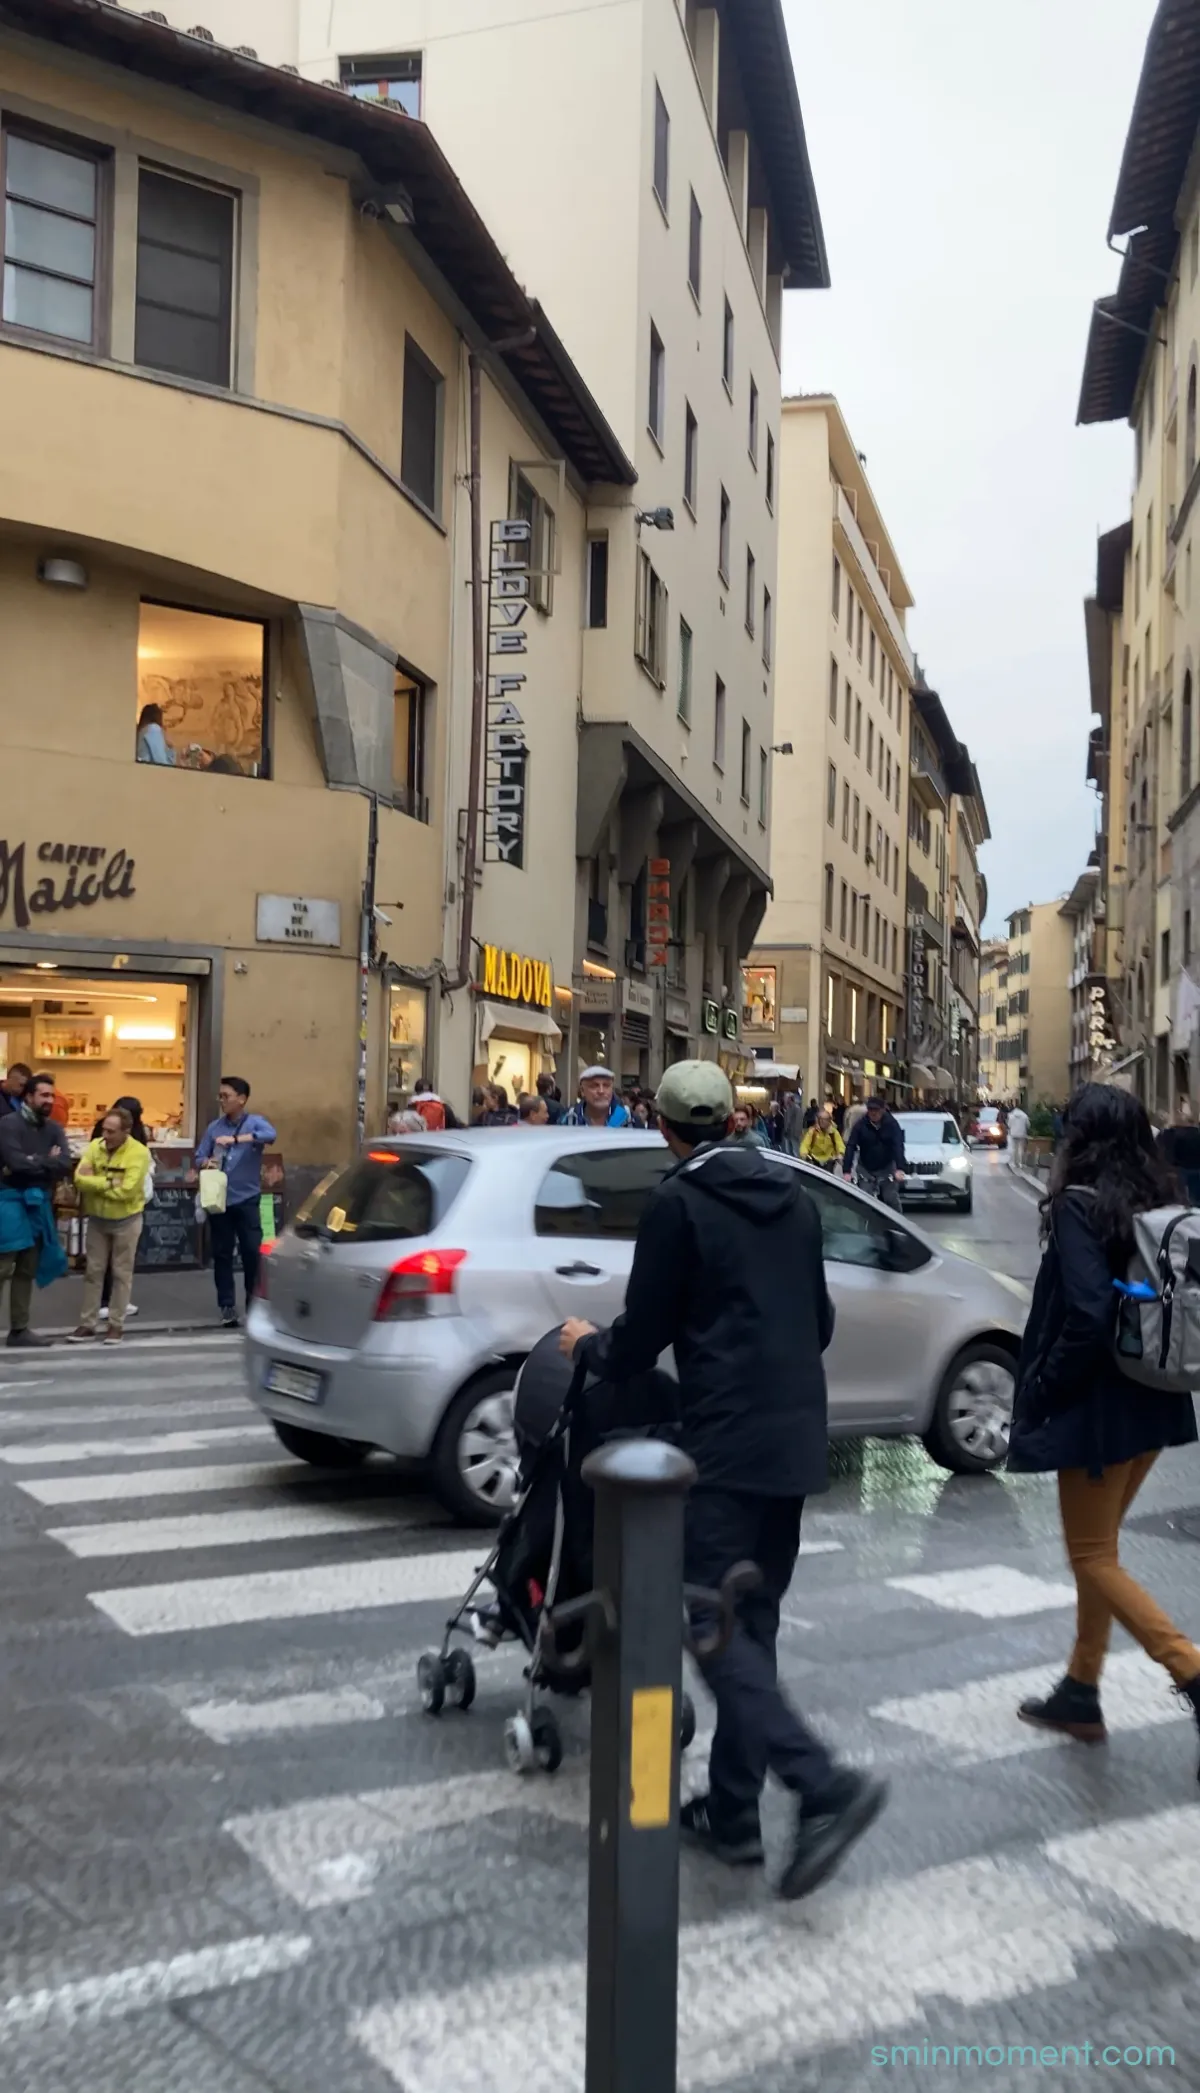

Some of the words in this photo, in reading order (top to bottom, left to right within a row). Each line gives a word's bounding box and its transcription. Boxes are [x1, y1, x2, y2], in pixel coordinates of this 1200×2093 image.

[496, 520, 530, 653] GLOVE
[492, 673, 527, 862] FACTORY
[292, 902, 309, 913] VIA
[483, 943, 552, 1008] MADOVA
[912, 913, 925, 1037] RISTORANTE
